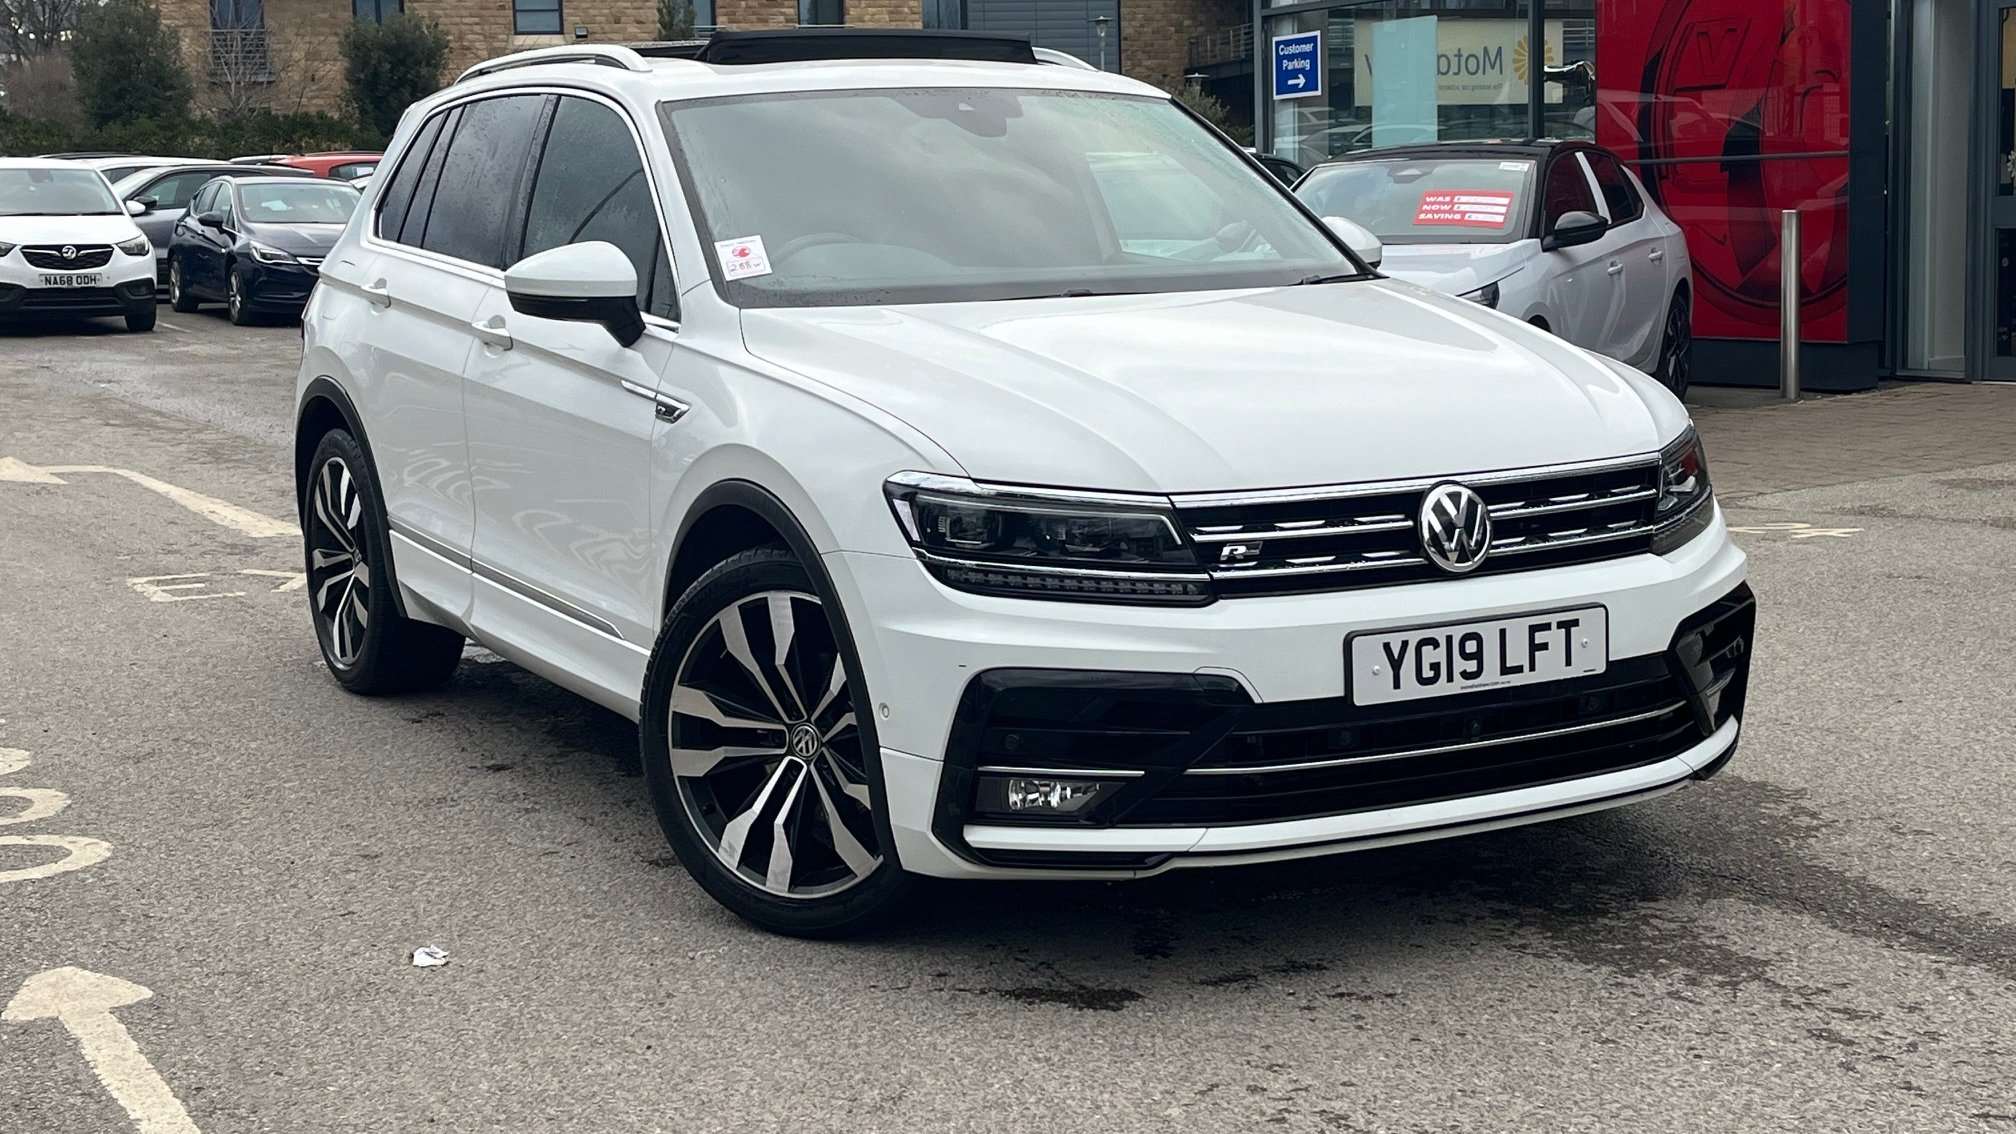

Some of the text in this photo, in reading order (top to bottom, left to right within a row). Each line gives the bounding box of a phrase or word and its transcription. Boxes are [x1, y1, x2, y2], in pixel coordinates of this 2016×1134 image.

[1278, 43, 1314, 55] Customer
[1282, 58, 1311, 70] Parking
[1418, 212, 1461, 220] SAVING
[44, 275, 73, 286] NA68
[1382, 618, 1580, 690] YG19 LFT
